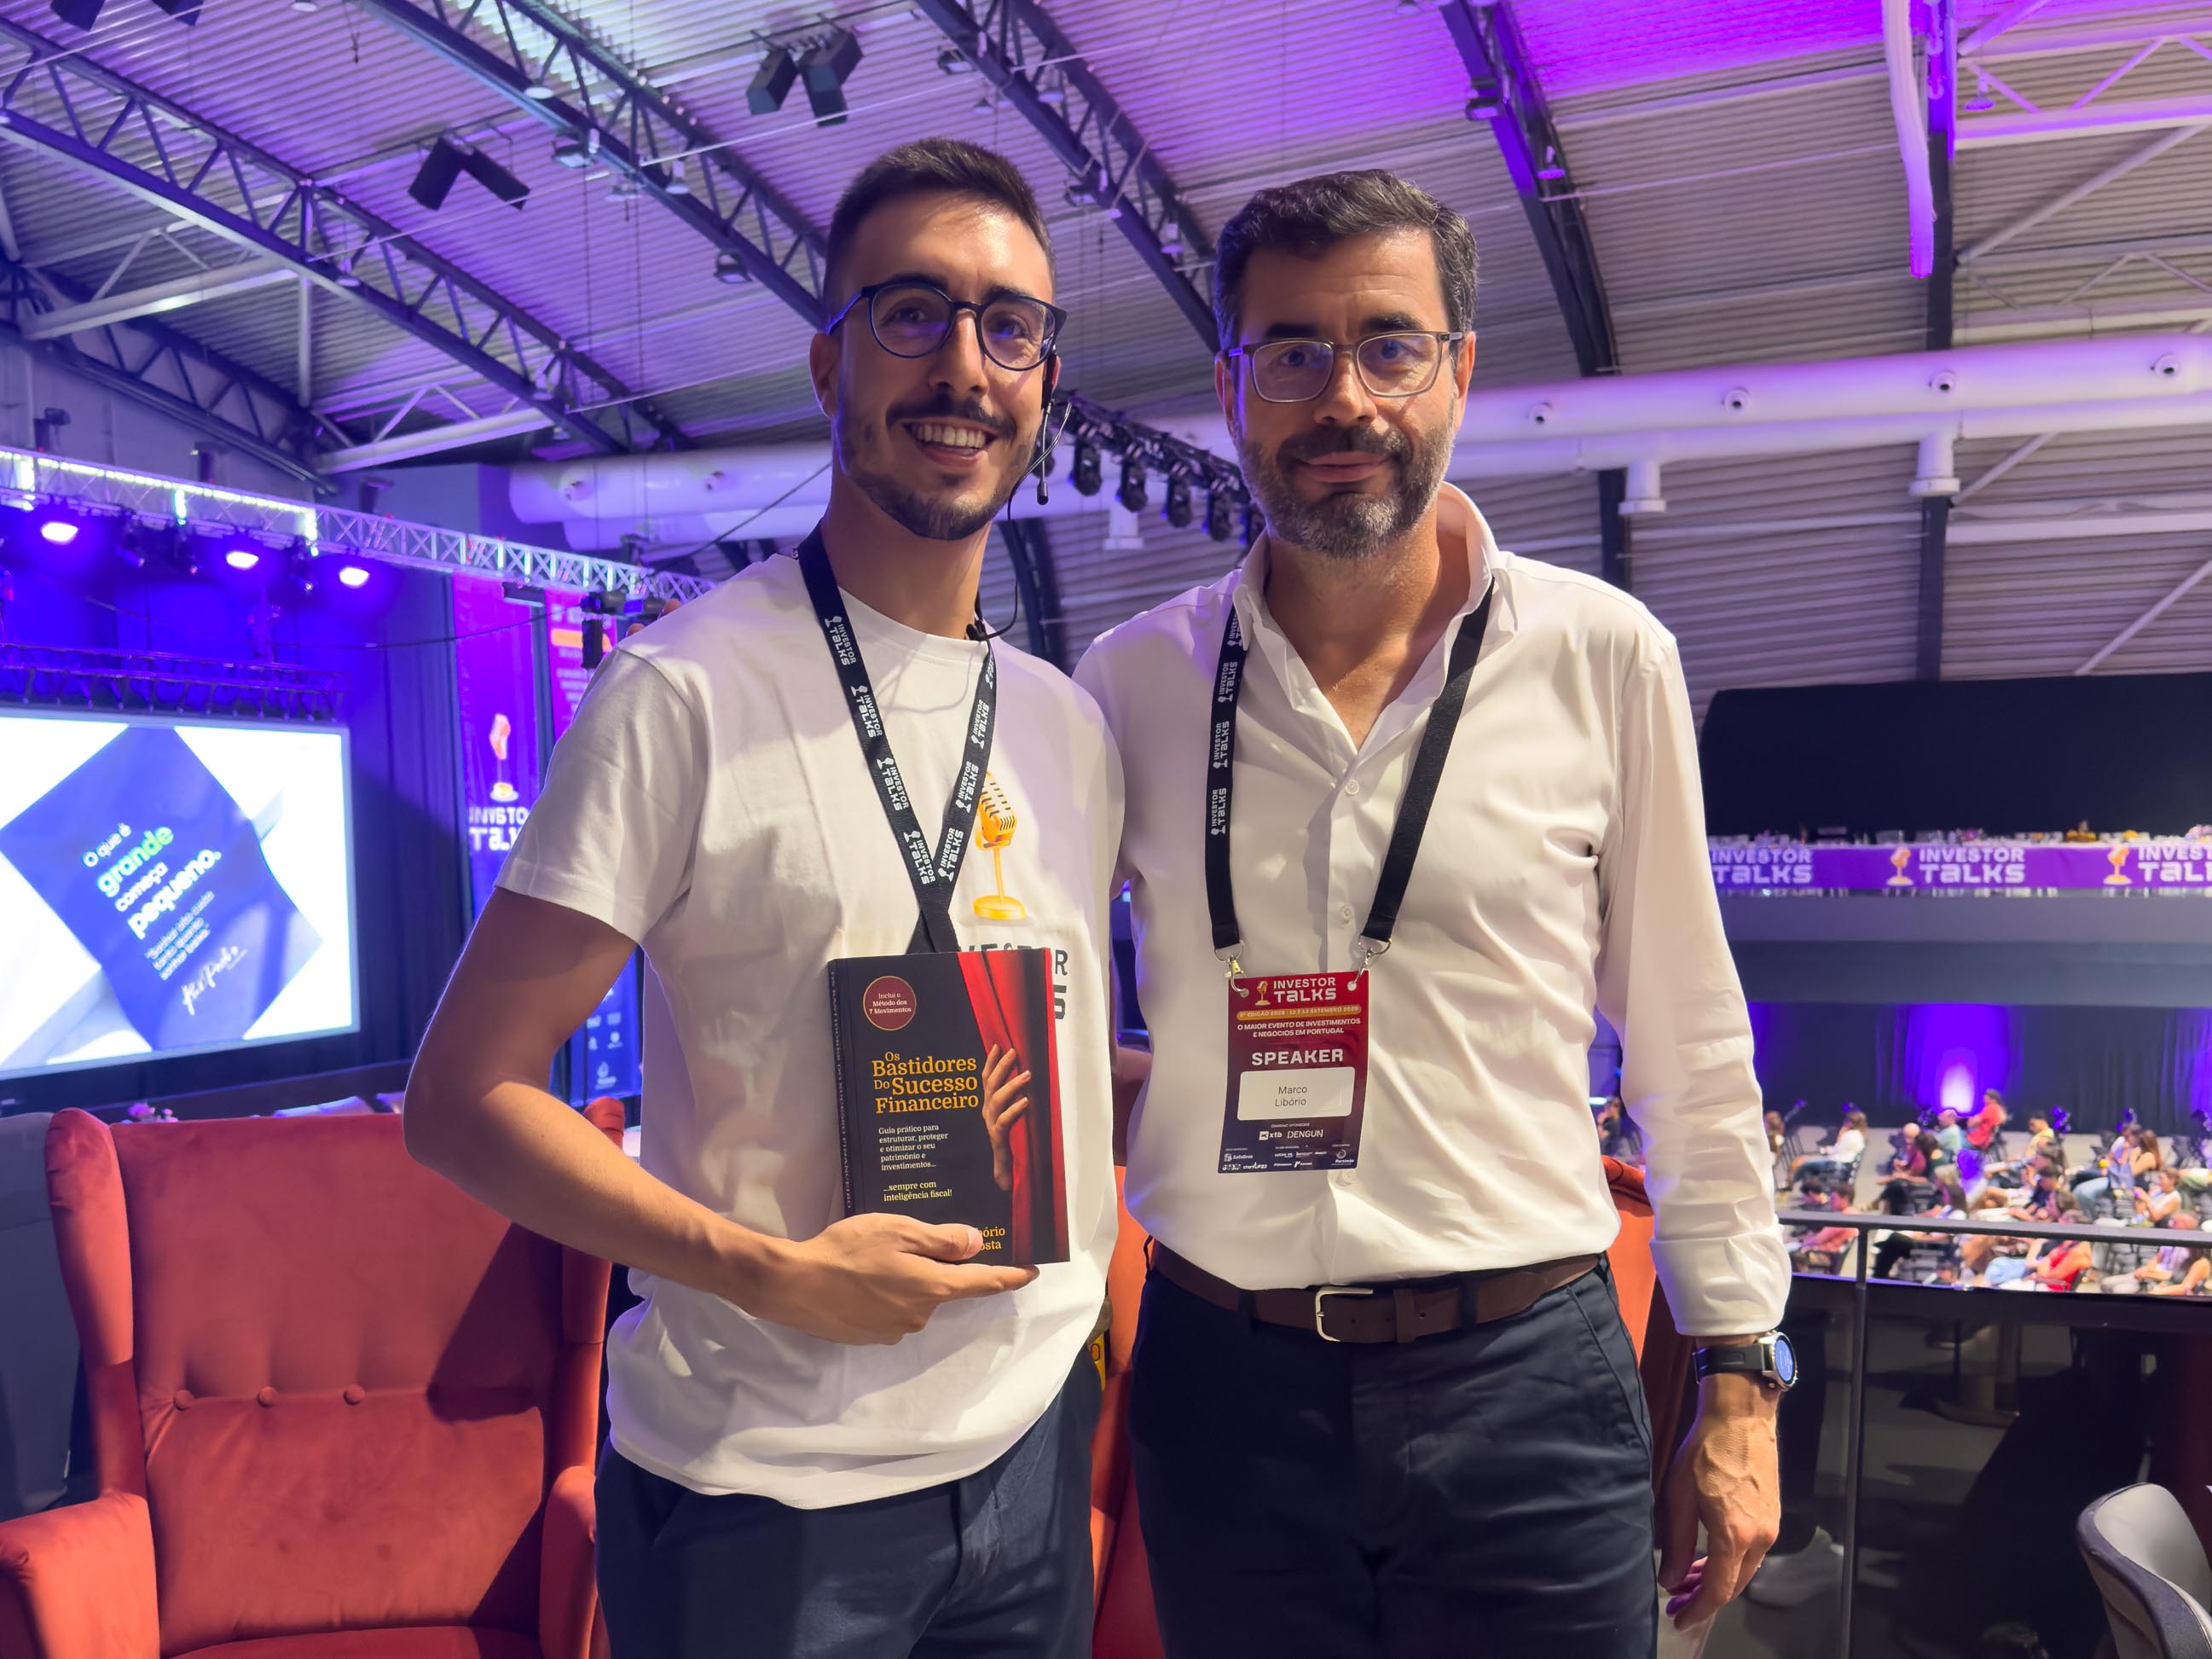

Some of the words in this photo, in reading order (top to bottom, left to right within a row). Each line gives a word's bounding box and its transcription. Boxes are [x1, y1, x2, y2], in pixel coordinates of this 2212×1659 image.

[838, 624, 856, 664] INVESTOR
[1219, 663, 1230, 695] INVESTOR
[864, 694, 883, 736] INVESTOR
[973, 699, 984, 735] INVESTOR
[890, 767, 909, 809] INVESTOR
[958, 761, 972, 799] INVESTOR
[941, 827, 955, 867] INVESTOR
[1919, 846, 2025, 863] INVESTOR
[96, 827, 174, 898] grande
[917, 840, 935, 883] INVESTOR
[1711, 849, 1812, 864] INVESTOR
[115, 861, 169, 912] começa
[127, 849, 222, 940] pequeno.
[1273, 977, 1336, 989] INVESTOR
[1306, 1018, 1361, 1027] INVESTIMENTOS
[884, 1051, 900, 1062] Os
[1251, 1048, 1344, 1066] SPEAKER
[871, 1056, 977, 1077] Bastidores
[873, 1079, 890, 1090] Do
[891, 1076, 978, 1095] Sucesso
[1277, 1086, 1308, 1094] Marco
[875, 1092, 979, 1114] Financeiro
[1275, 1098, 1306, 1107] Libório
[897, 1125, 921, 1134] prático
[923, 1124, 939, 1133] para
[1287, 1129, 1323, 1139] DENGUN
[879, 1134, 917, 1144] estruturar,
[918, 1133, 948, 1142] proteger
[885, 1144, 915, 1152] otimizar
[880, 1152, 920, 1163] património
[881, 1161, 936, 1171] investimentos...
[883, 1191, 929, 1202] inteligência
[929, 1188, 953, 1198] fiscal!
[979, 1226, 1005, 1238] ório
[981, 1240, 1002, 1251] osta
